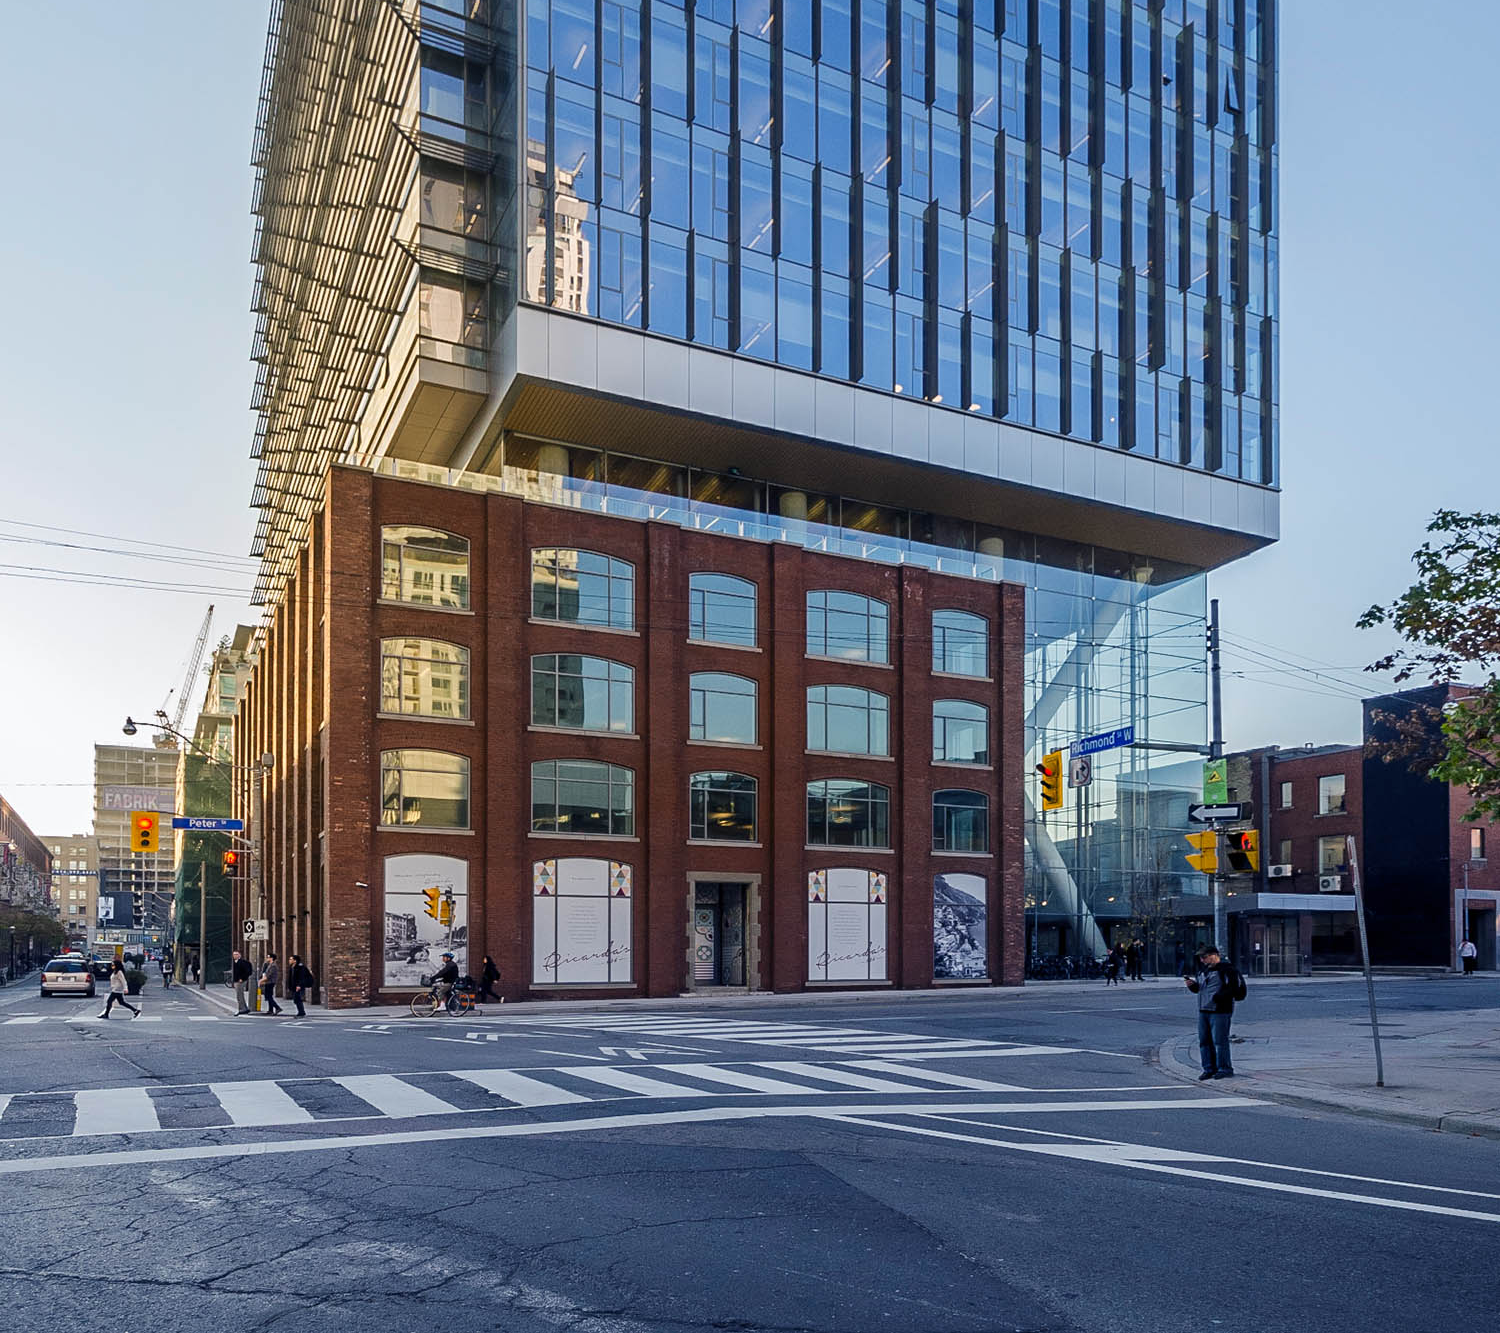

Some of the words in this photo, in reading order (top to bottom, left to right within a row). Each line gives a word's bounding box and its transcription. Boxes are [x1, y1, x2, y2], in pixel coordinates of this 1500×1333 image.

[1071, 732, 1116, 754] Richmond
[1123, 729, 1132, 741] W
[104, 793, 158, 810] FABRIK
[189, 819, 217, 828] Peter
